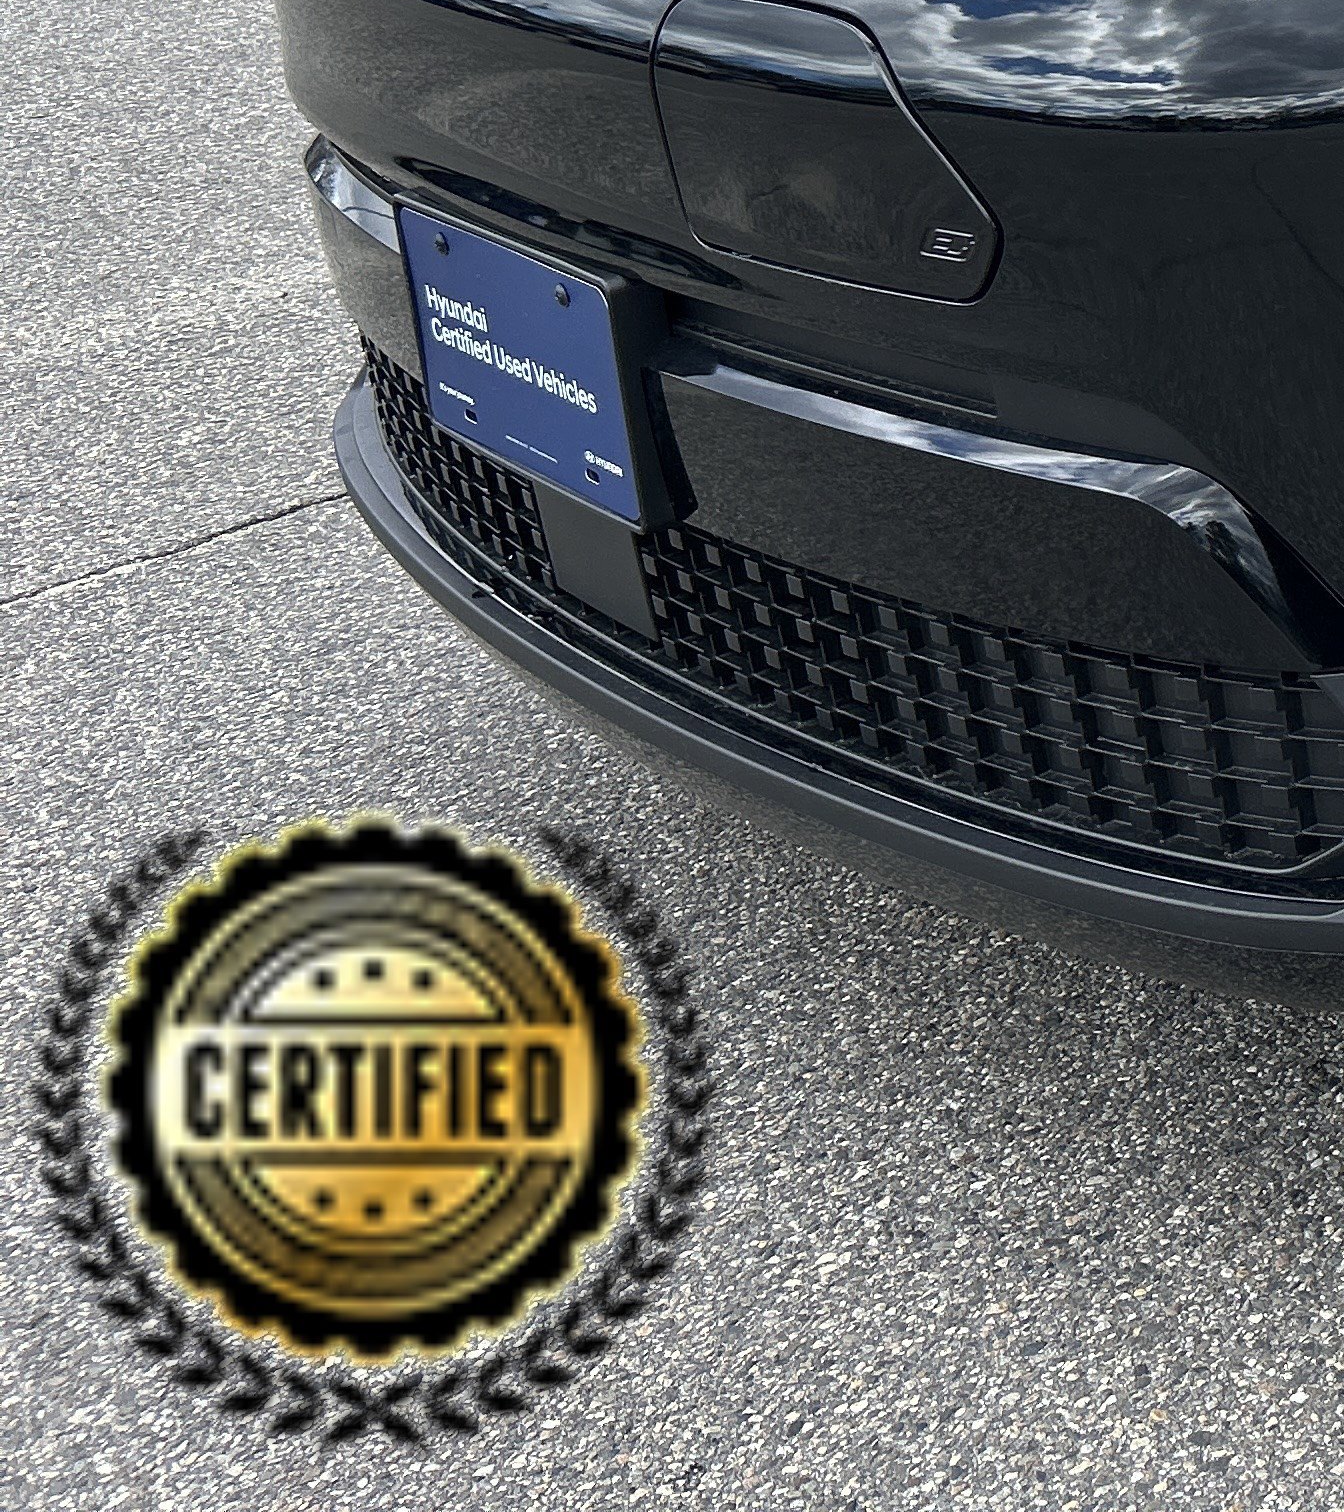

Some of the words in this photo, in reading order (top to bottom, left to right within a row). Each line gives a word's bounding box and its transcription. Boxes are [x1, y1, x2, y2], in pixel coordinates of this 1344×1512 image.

[424, 284, 488, 333] Hyundai
[431, 317, 493, 366] Certified
[495, 344, 533, 384] Used
[532, 362, 598, 415] Vehicles
